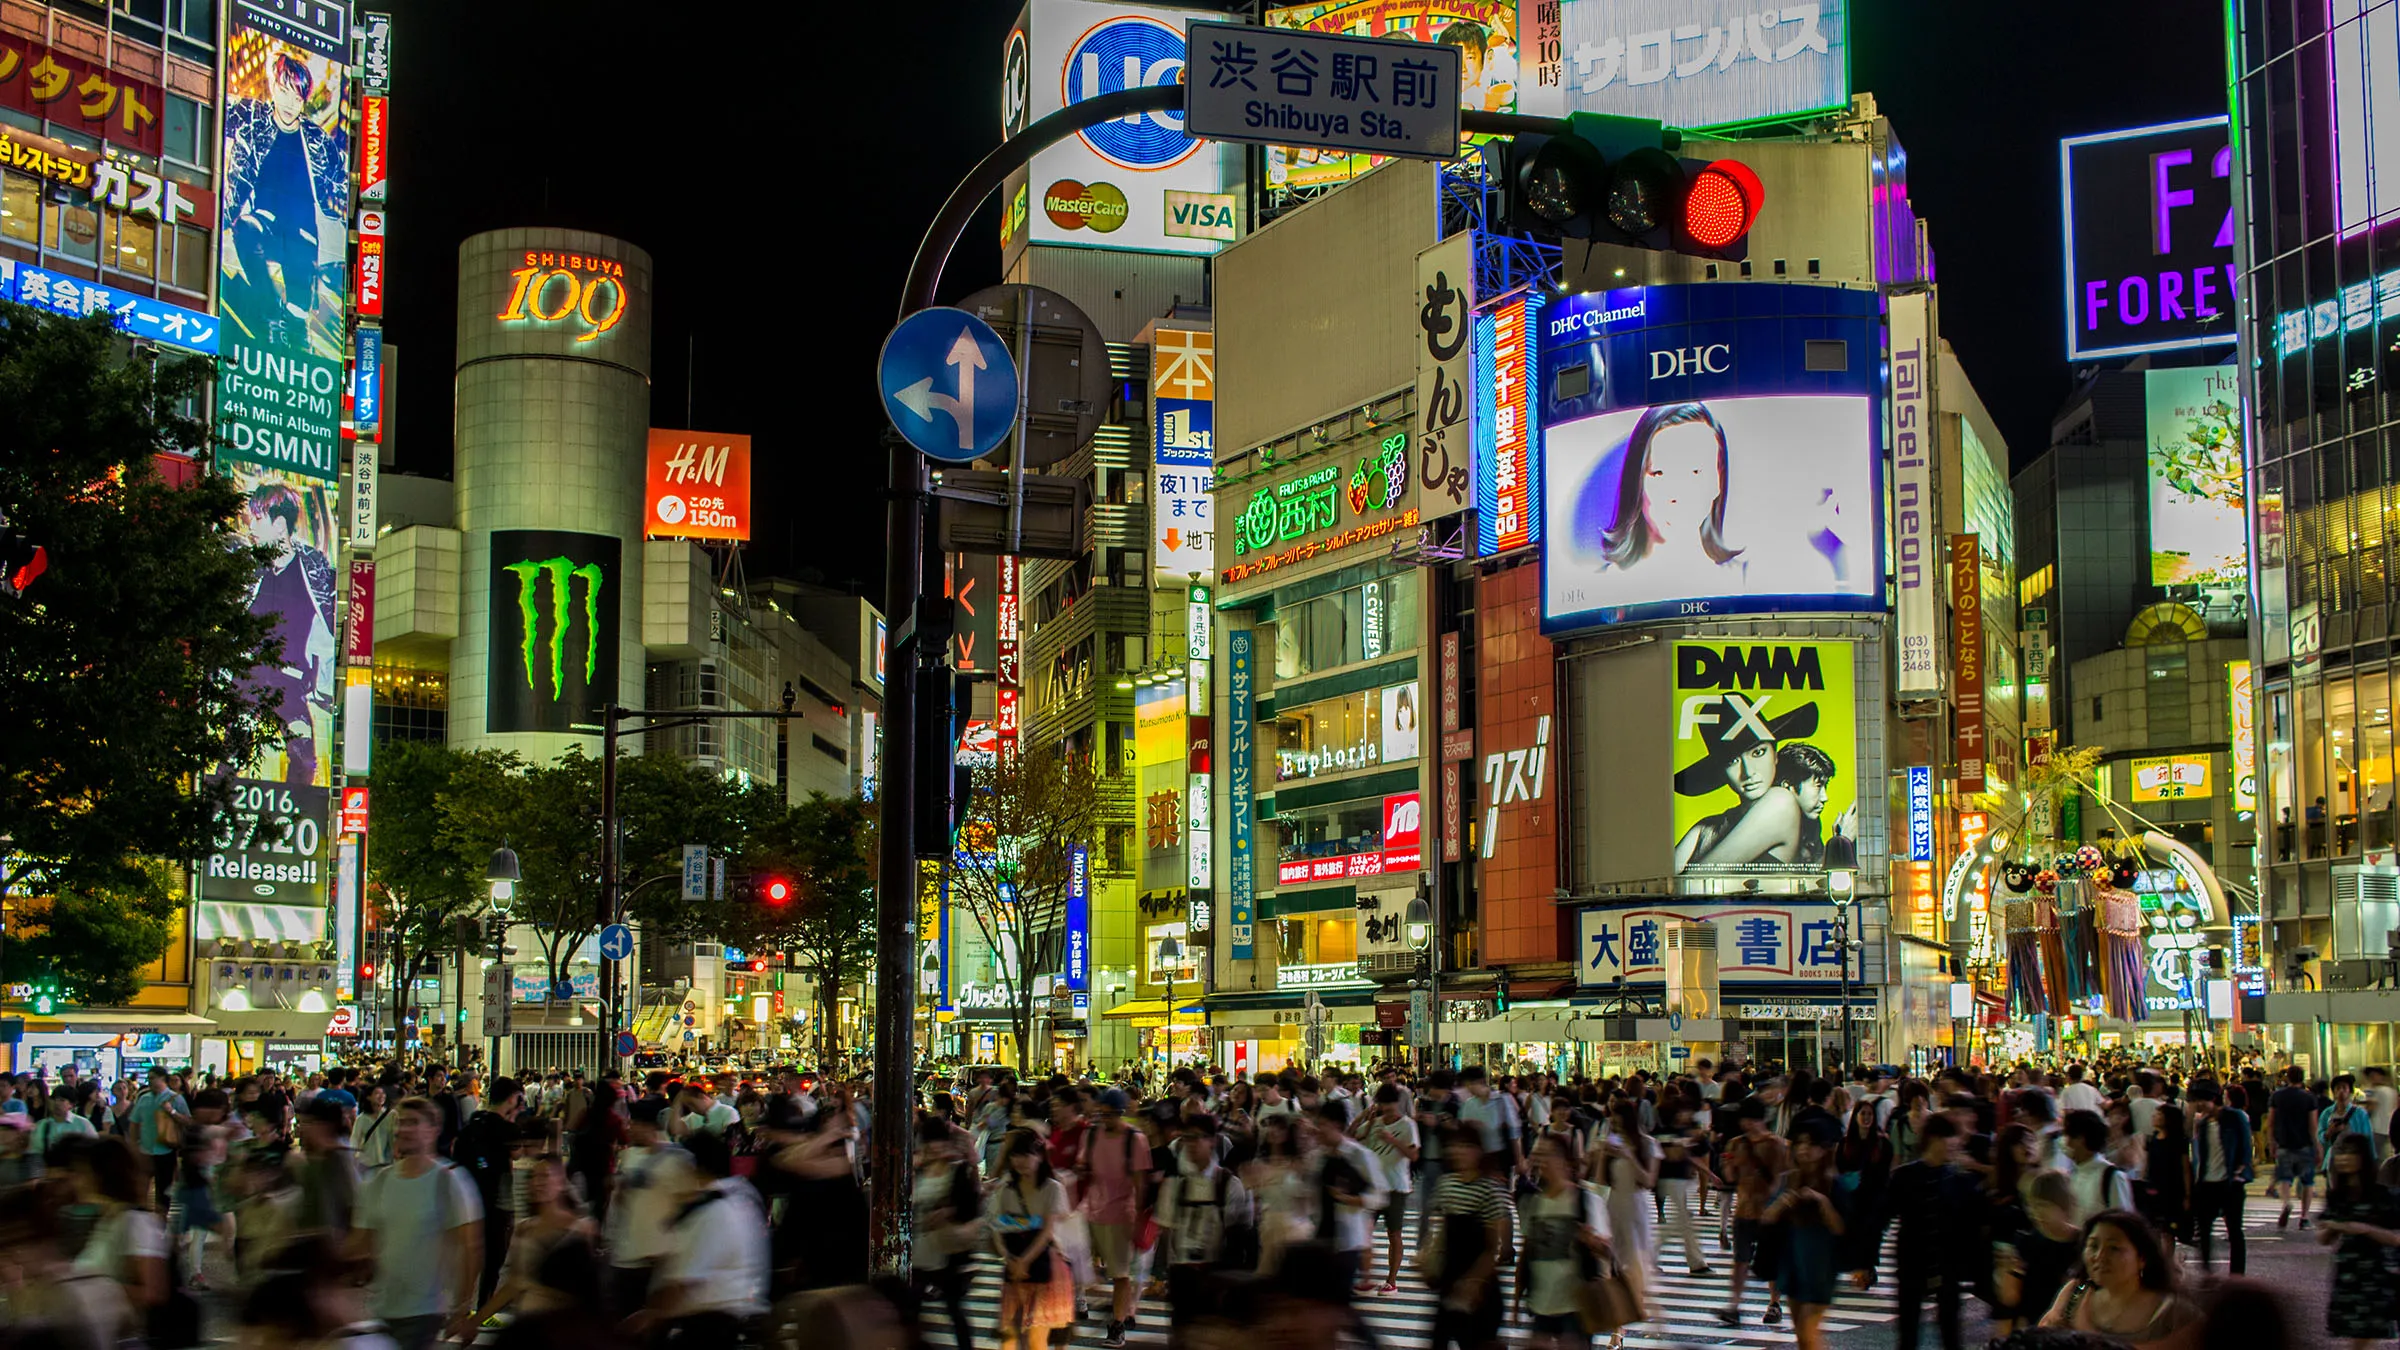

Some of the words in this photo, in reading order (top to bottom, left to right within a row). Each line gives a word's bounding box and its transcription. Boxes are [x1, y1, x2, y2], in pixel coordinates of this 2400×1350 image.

[248, 13, 281, 31] JUNHO
[286, 24, 311, 44] From
[314, 39, 334, 53] 2PM
[1574, 8, 1829, 95] サロンパス
[1208, 40, 1440, 110] 渋谷駅前
[1244, 101, 1350, 139] Shibuya
[1359, 111, 1411, 141] Sta.
[92, 158, 196, 224] ガスト
[370, 190, 383, 199] 8F
[1045, 195, 1126, 218] MasterCard
[1173, 204, 1235, 229] VISA
[362, 255, 380, 305] ガスト
[525, 252, 624, 277] SHIBUYA
[497, 267, 628, 344] 109
[1551, 315, 1582, 336] DHC
[1583, 301, 1646, 326] Channel
[225, 344, 334, 395] JUNHO
[360, 337, 377, 420] 英会話イーオン
[1650, 343, 1731, 380] DHC
[225, 373, 280, 404] (From
[286, 389, 333, 419] 2PM)
[1420, 270, 1469, 505] もんじゃ
[1895, 338, 1924, 469] Taisei
[2203, 370, 2238, 397] Thi
[224, 399, 248, 418] 4th
[252, 406, 283, 426] Mini
[287, 416, 332, 439] Album
[359, 423, 373, 431] 6F
[1163, 414, 1174, 444] BOOK
[1494, 314, 1518, 536] 三千里薬品
[666, 443, 730, 487] H&M
[1163, 449, 1213, 460] ブックファース
[355, 453, 373, 539] 渋谷駅前ビル
[689, 497, 725, 510] この先
[1172, 499, 1209, 518] まで
[1280, 484, 1338, 541] 西村
[689, 509, 737, 529] 150m
[1235, 516, 1246, 556] 渋谷
[1900, 482, 1922, 589] neon
[353, 563, 374, 574] 5F
[1367, 597, 1381, 659] CAMERA
[1680, 602, 1710, 614] DHC
[1957, 540, 1977, 682] クスリのことなら
[1902, 648, 1931, 661] 3719
[1904, 635, 1928, 648] (03)
[1677, 645, 1825, 691] DMM
[1902, 660, 1932, 672] 2468
[1139, 713, 1175, 729] Matsumoto
[1678, 694, 1776, 741] FX
[1958, 693, 1983, 780] 三千里
[1232, 672, 1250, 836] サマーフルーツギフト
[1281, 739, 1378, 778] Euphoria
[233, 785, 301, 815] 2016.
[1147, 789, 1181, 849] 薬
[1912, 771, 1929, 857] 大盛堂商事ビル
[1386, 801, 1420, 840] JTB
[209, 854, 318, 884] Release!!
[1073, 852, 1084, 897] MIZUHO
[1350, 854, 1380, 866] ハネムーン
[1071, 929, 1082, 979] みずほ銀行
[1590, 918, 1842, 970] 大盛書店
[1799, 970, 1822, 978] BOOKS
[1824, 970, 1856, 979] TAISDO
[487, 971, 498, 1029] 道玄坂
[268, 1043, 288, 1051] SHIBUYA
